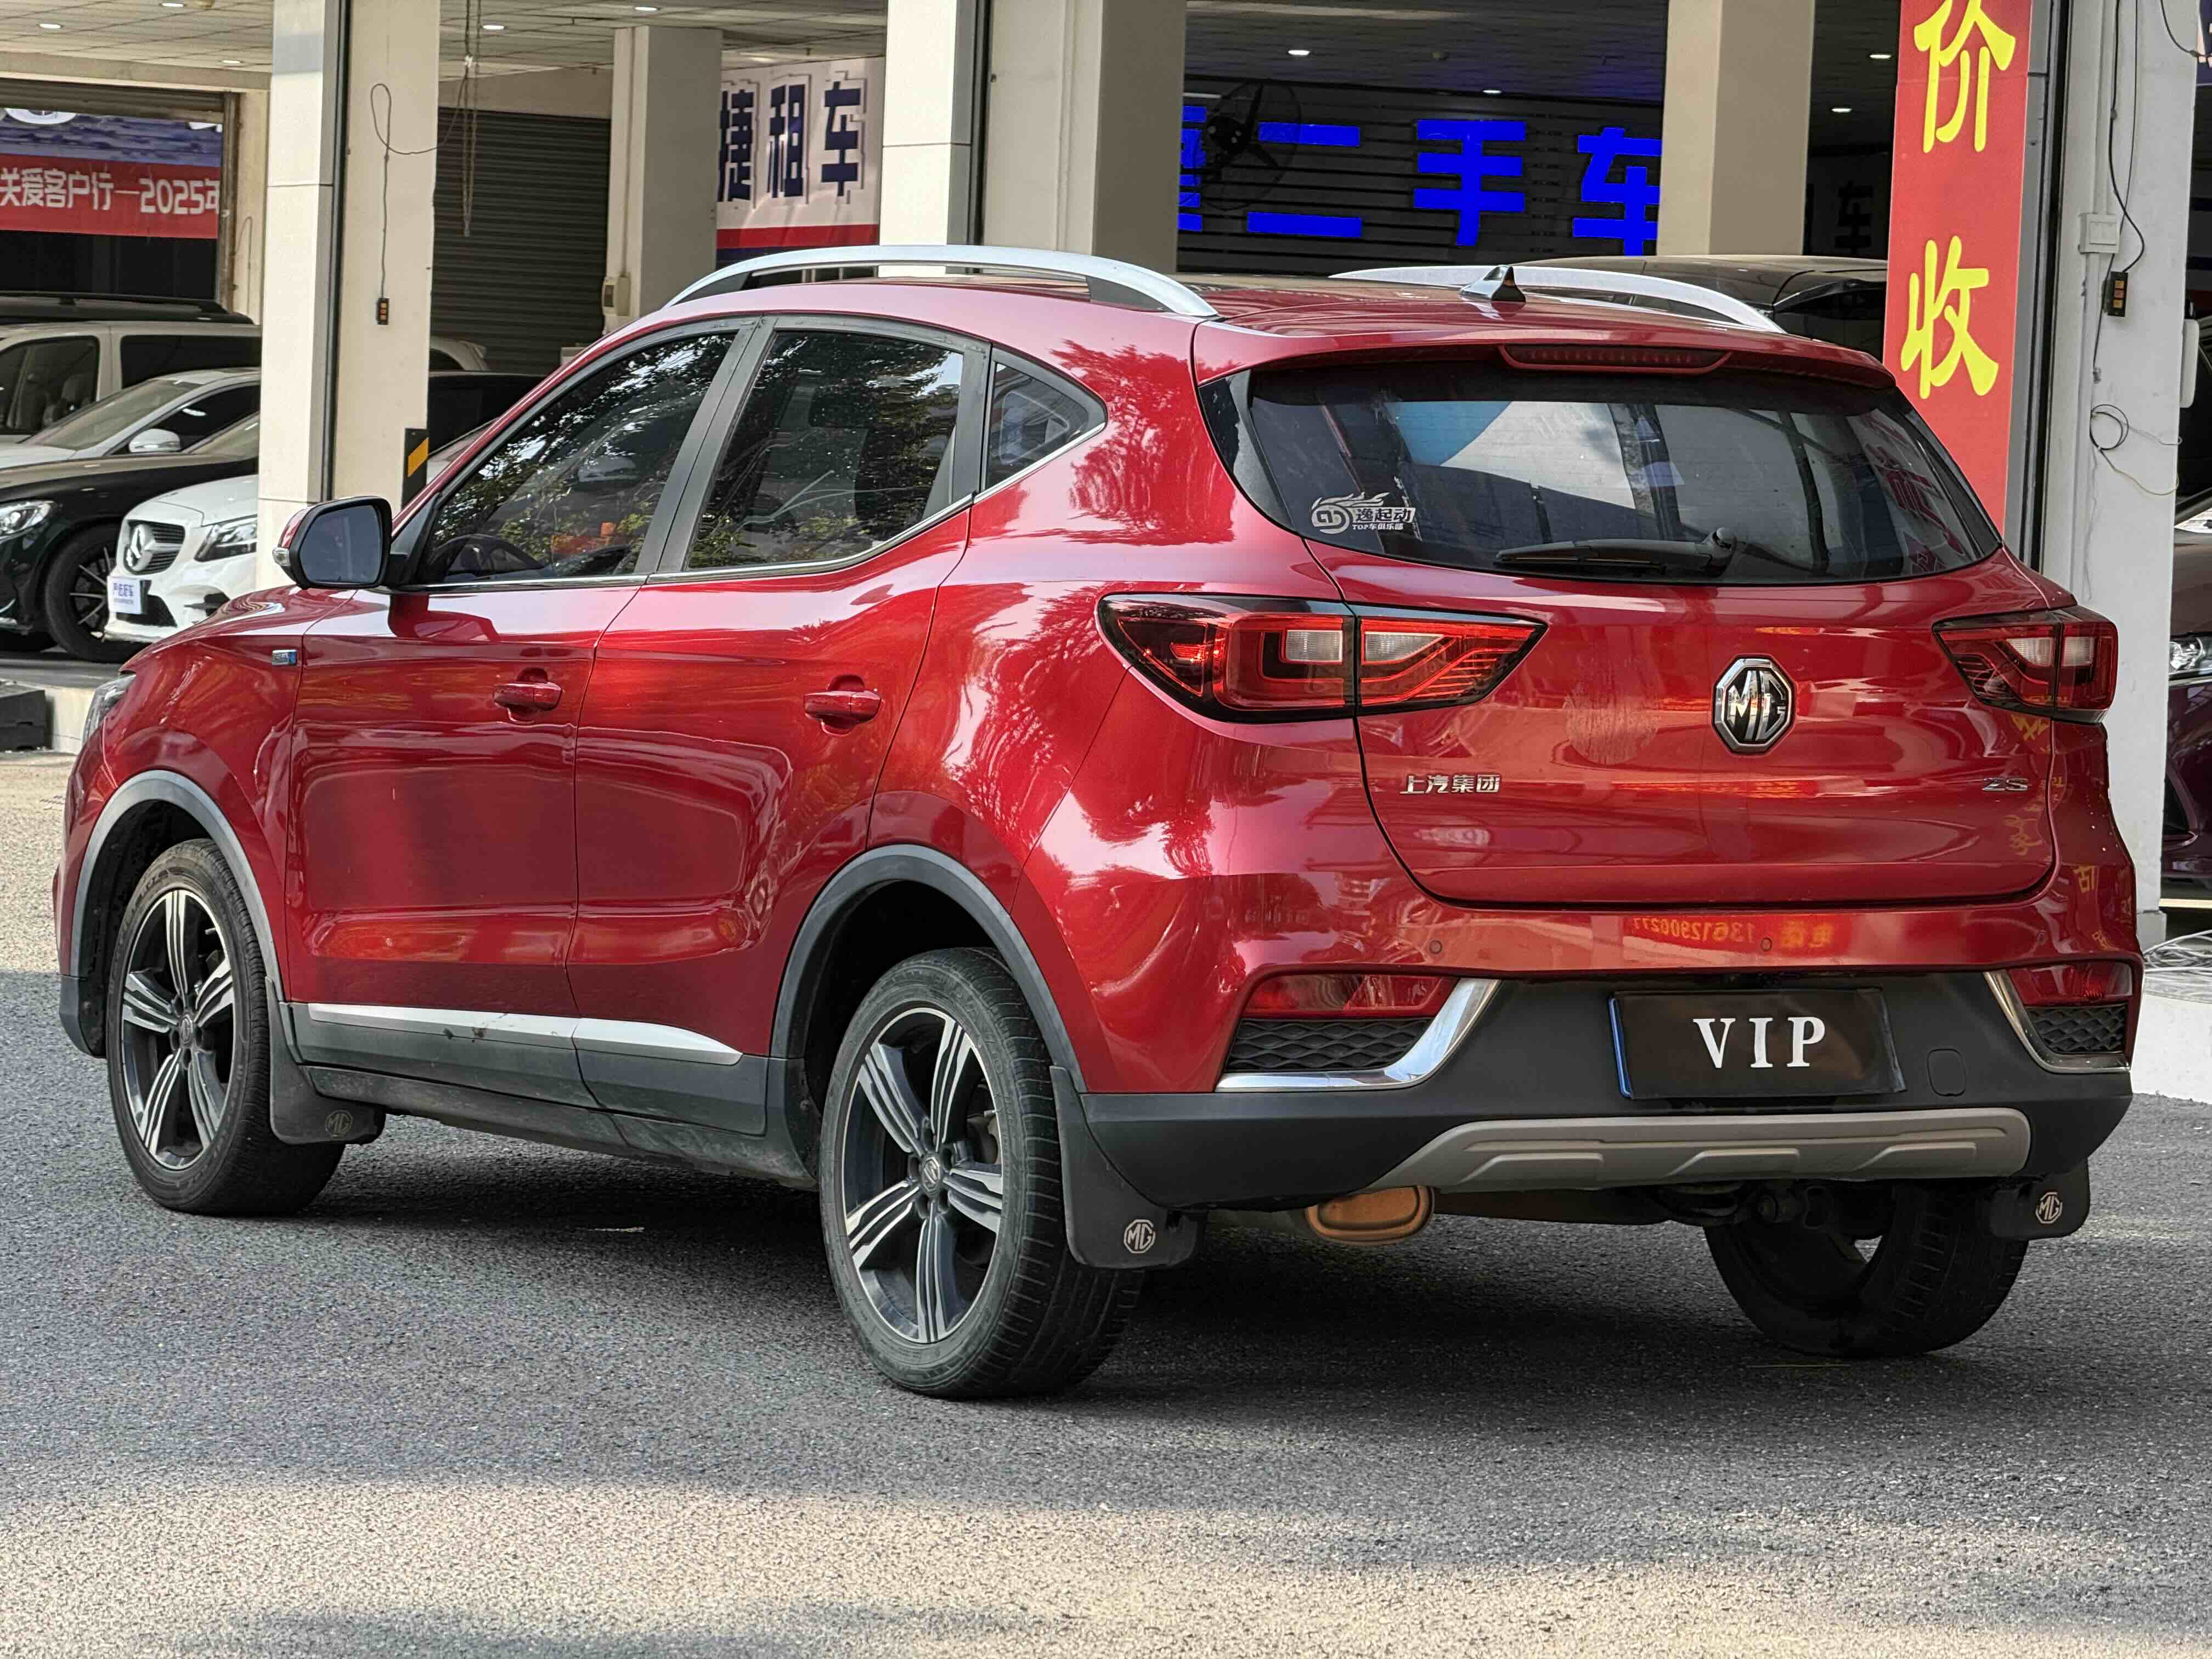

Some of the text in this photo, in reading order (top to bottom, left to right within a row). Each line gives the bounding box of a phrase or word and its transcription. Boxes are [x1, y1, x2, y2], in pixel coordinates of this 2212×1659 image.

[718, 81, 861, 202] 捷租车
[1356, 508, 1412, 522] 逸起动
[1726, 670, 1787, 741] MG
[1400, 774, 1500, 794] 上汽集团
[1982, 777, 2028, 791] ZS
[1693, 1017, 1826, 1069] VIP
[327, 1113, 351, 1134] MG
[2038, 1195, 2061, 1221] MG
[1127, 1222, 1153, 1250] MG
